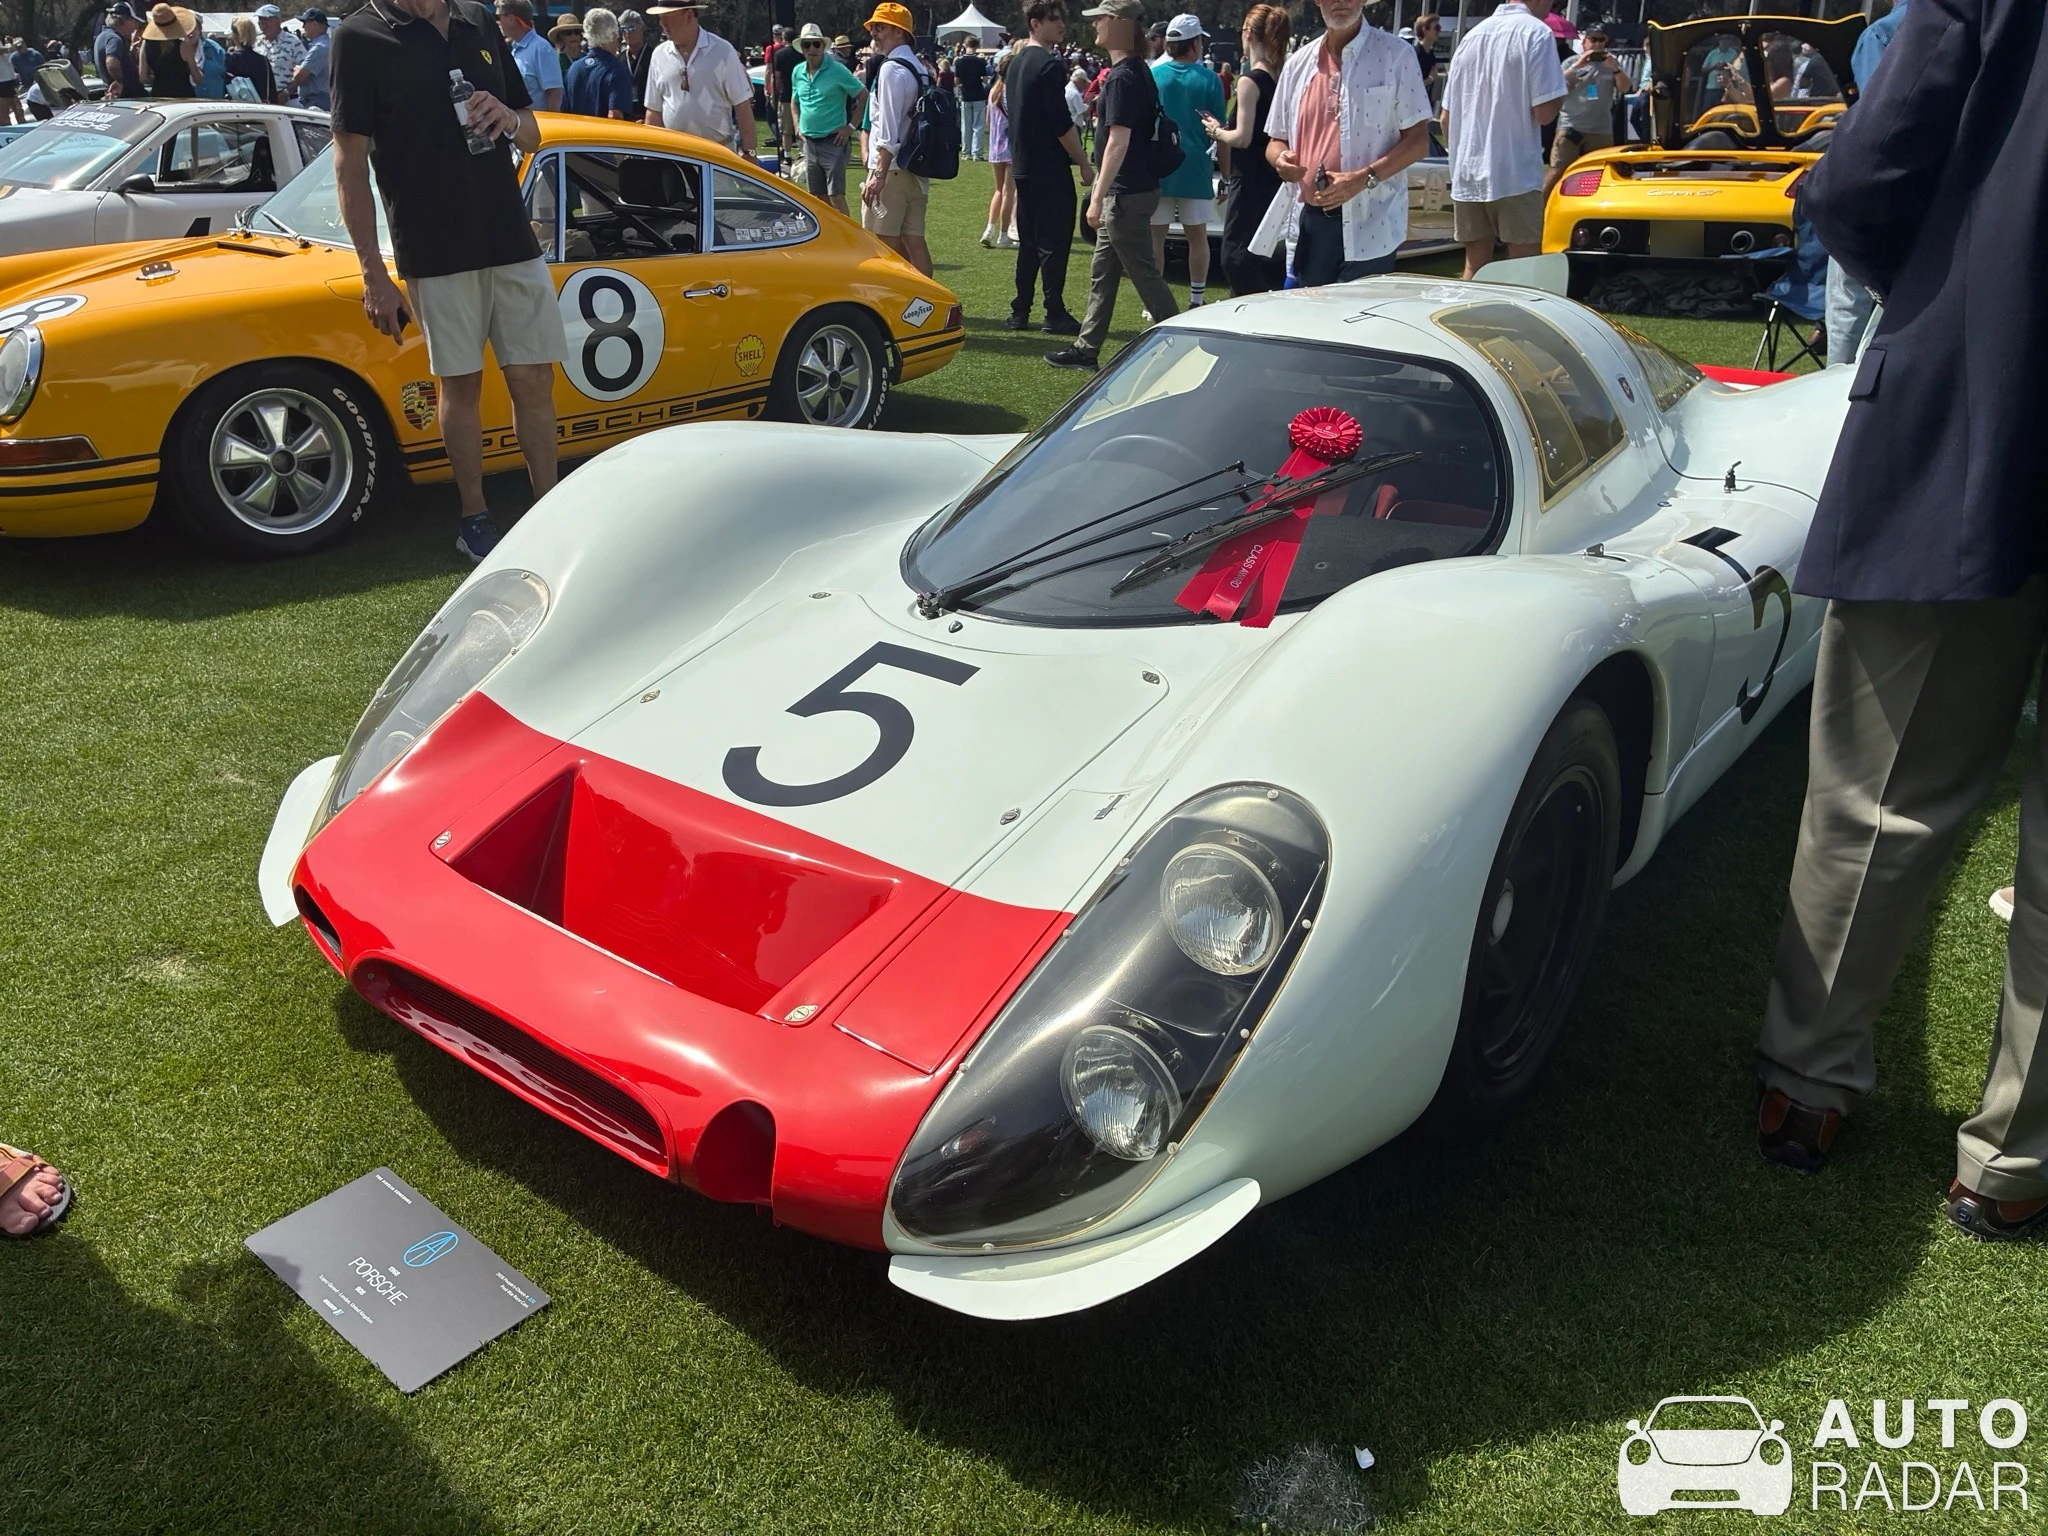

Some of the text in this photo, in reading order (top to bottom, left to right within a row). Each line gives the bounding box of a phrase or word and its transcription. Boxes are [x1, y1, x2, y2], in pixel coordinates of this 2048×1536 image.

[48, 119, 112, 131] PORSCHE
[578, 275, 644, 392] 8
[903, 304, 933, 320] GOODYEAR
[738, 348, 762, 362] SHELL
[332, 387, 377, 522] GOODYEAR
[1242, 544, 1264, 570] CLASS
[1677, 526, 1792, 726] 5
[722, 641, 982, 808] 5
[347, 1256, 409, 1306] PORSCHE
